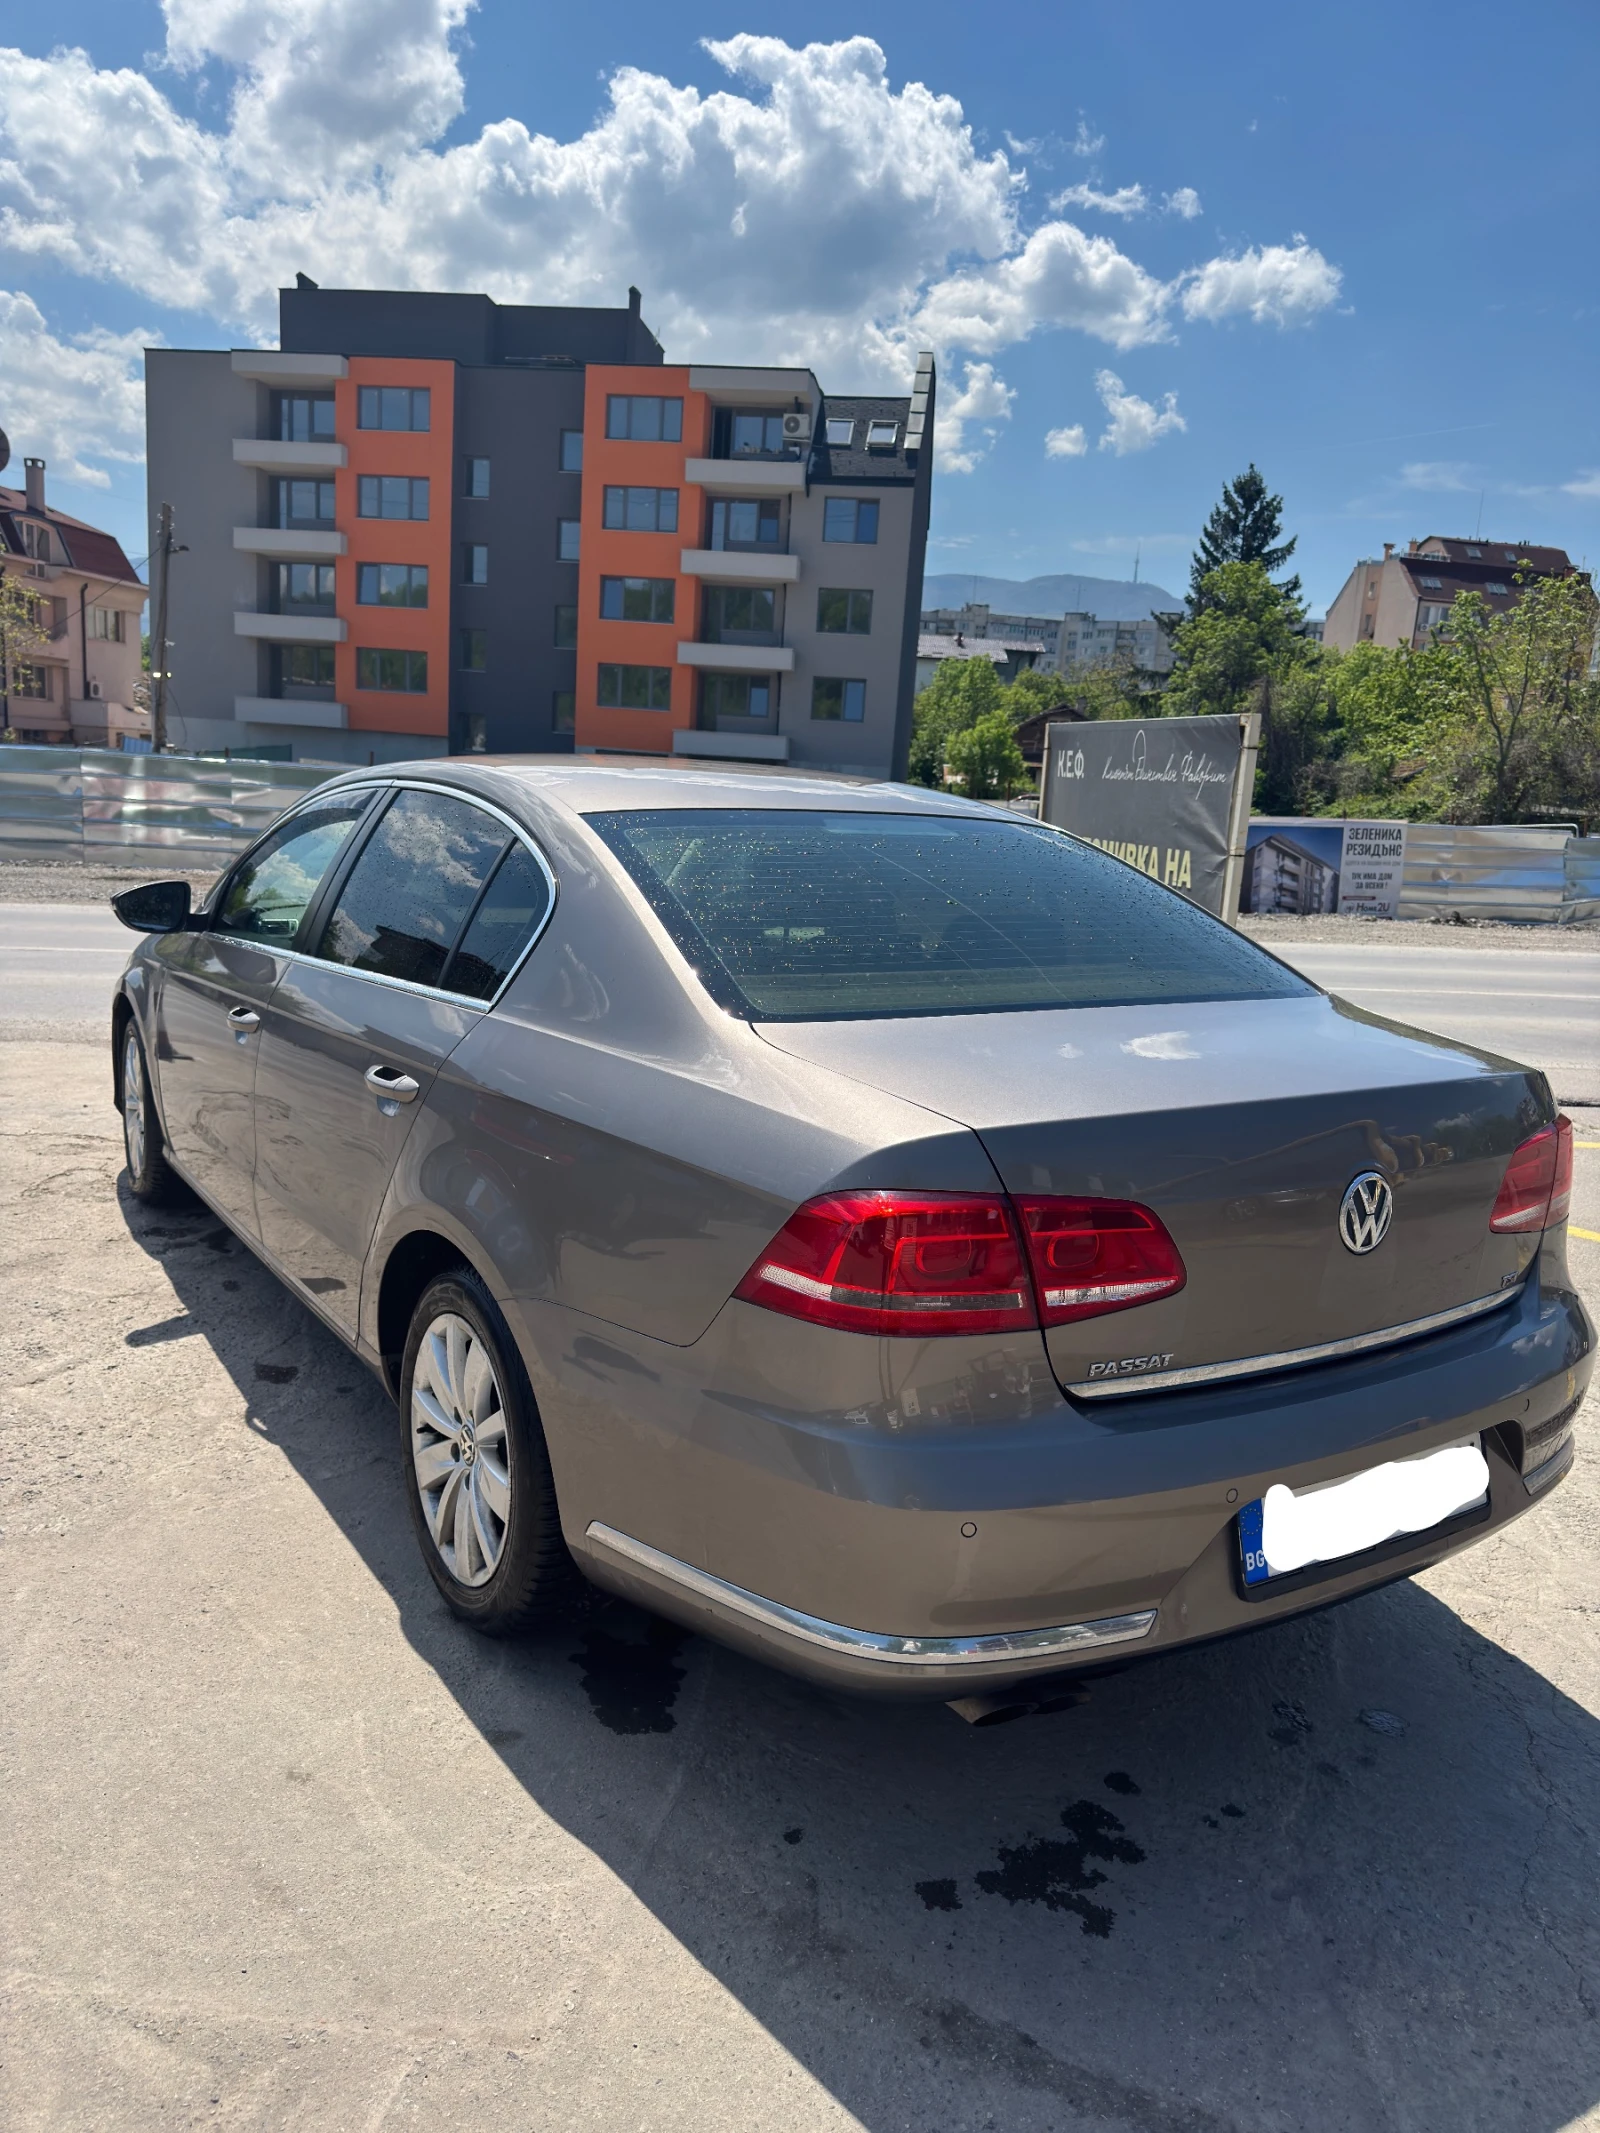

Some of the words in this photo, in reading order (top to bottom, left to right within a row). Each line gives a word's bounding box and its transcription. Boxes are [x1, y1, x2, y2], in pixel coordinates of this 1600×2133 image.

[1057, 749, 1085, 779] К.Е.Ф.
[1348, 827, 1402, 841] ЗЕЛЕНИКА
[1346, 843, 1403, 858] РЕЗИДЪНС
[1164, 848, 1192, 888] НА
[1341, 1172, 1393, 1253] VW
[1088, 1353, 1174, 1377] PASSAT
[1245, 1549, 1265, 1571] BG
